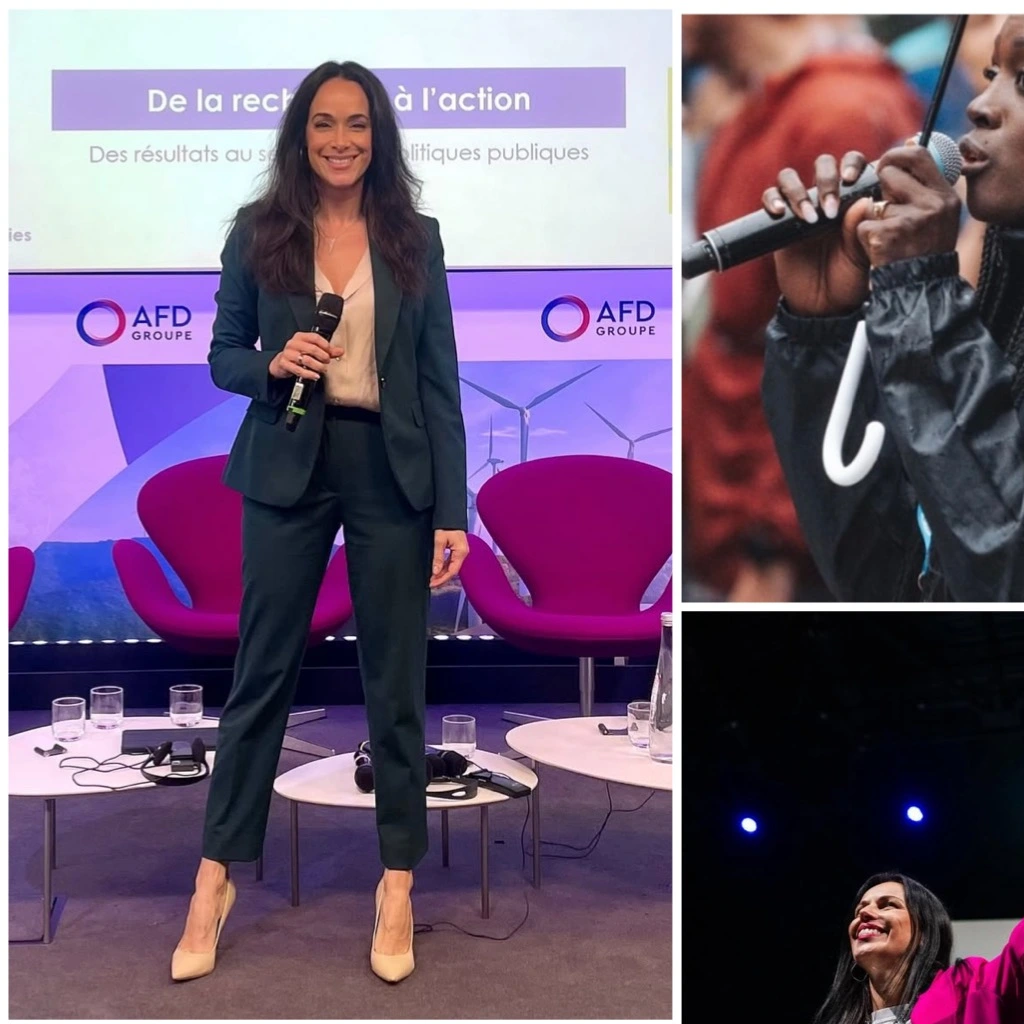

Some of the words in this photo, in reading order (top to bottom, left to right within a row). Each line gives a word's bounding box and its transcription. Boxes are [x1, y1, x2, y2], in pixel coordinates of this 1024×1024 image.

[148, 88, 188, 113] De
[196, 87, 223, 113] la
[394, 85, 413, 111] à
[89, 145, 128, 163] Des
[133, 143, 219, 163] résultats
[224, 147, 253, 163] au
[487, 142, 590, 166] publiques
[8, 227, 32, 242] ies
[131, 305, 192, 328] AFD
[596, 300, 656, 323] AFD
[131, 330, 193, 341] GROUPE
[595, 325, 656, 336] GROUPE
